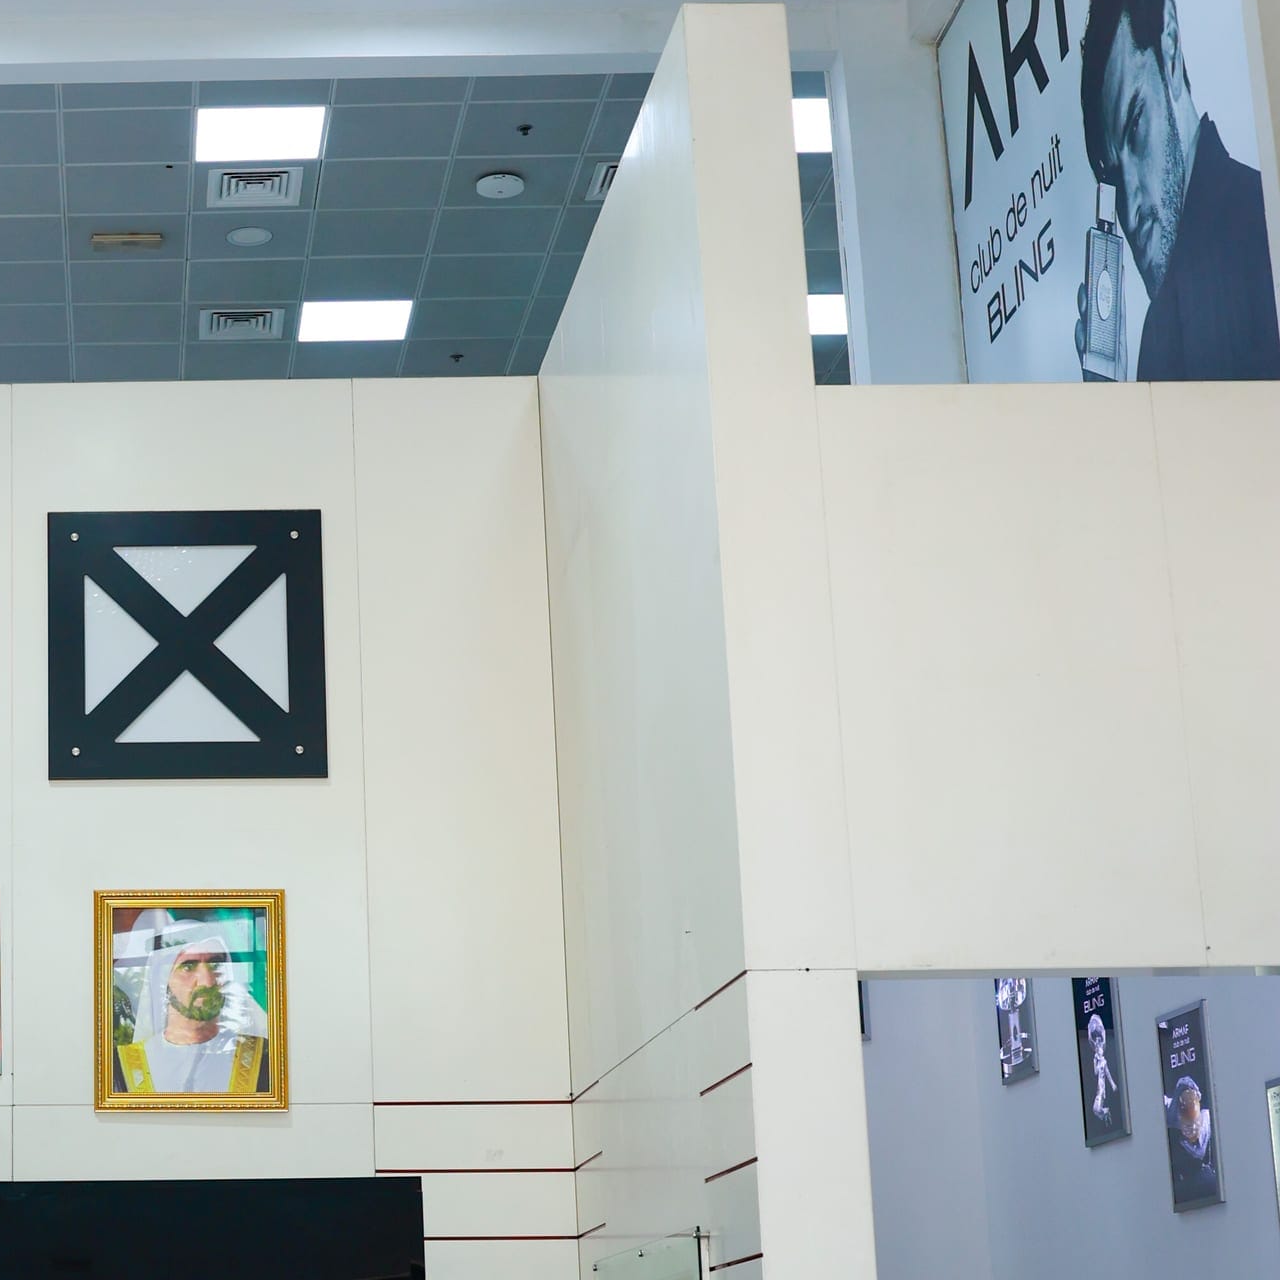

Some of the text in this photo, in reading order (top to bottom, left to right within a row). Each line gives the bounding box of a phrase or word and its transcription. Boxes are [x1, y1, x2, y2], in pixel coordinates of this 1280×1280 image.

[970, 133, 1064, 294] club de nuit
[986, 218, 1055, 345] BLING
[1084, 994, 1104, 1013] BLING
[1171, 1047, 1196, 1068] BLING
